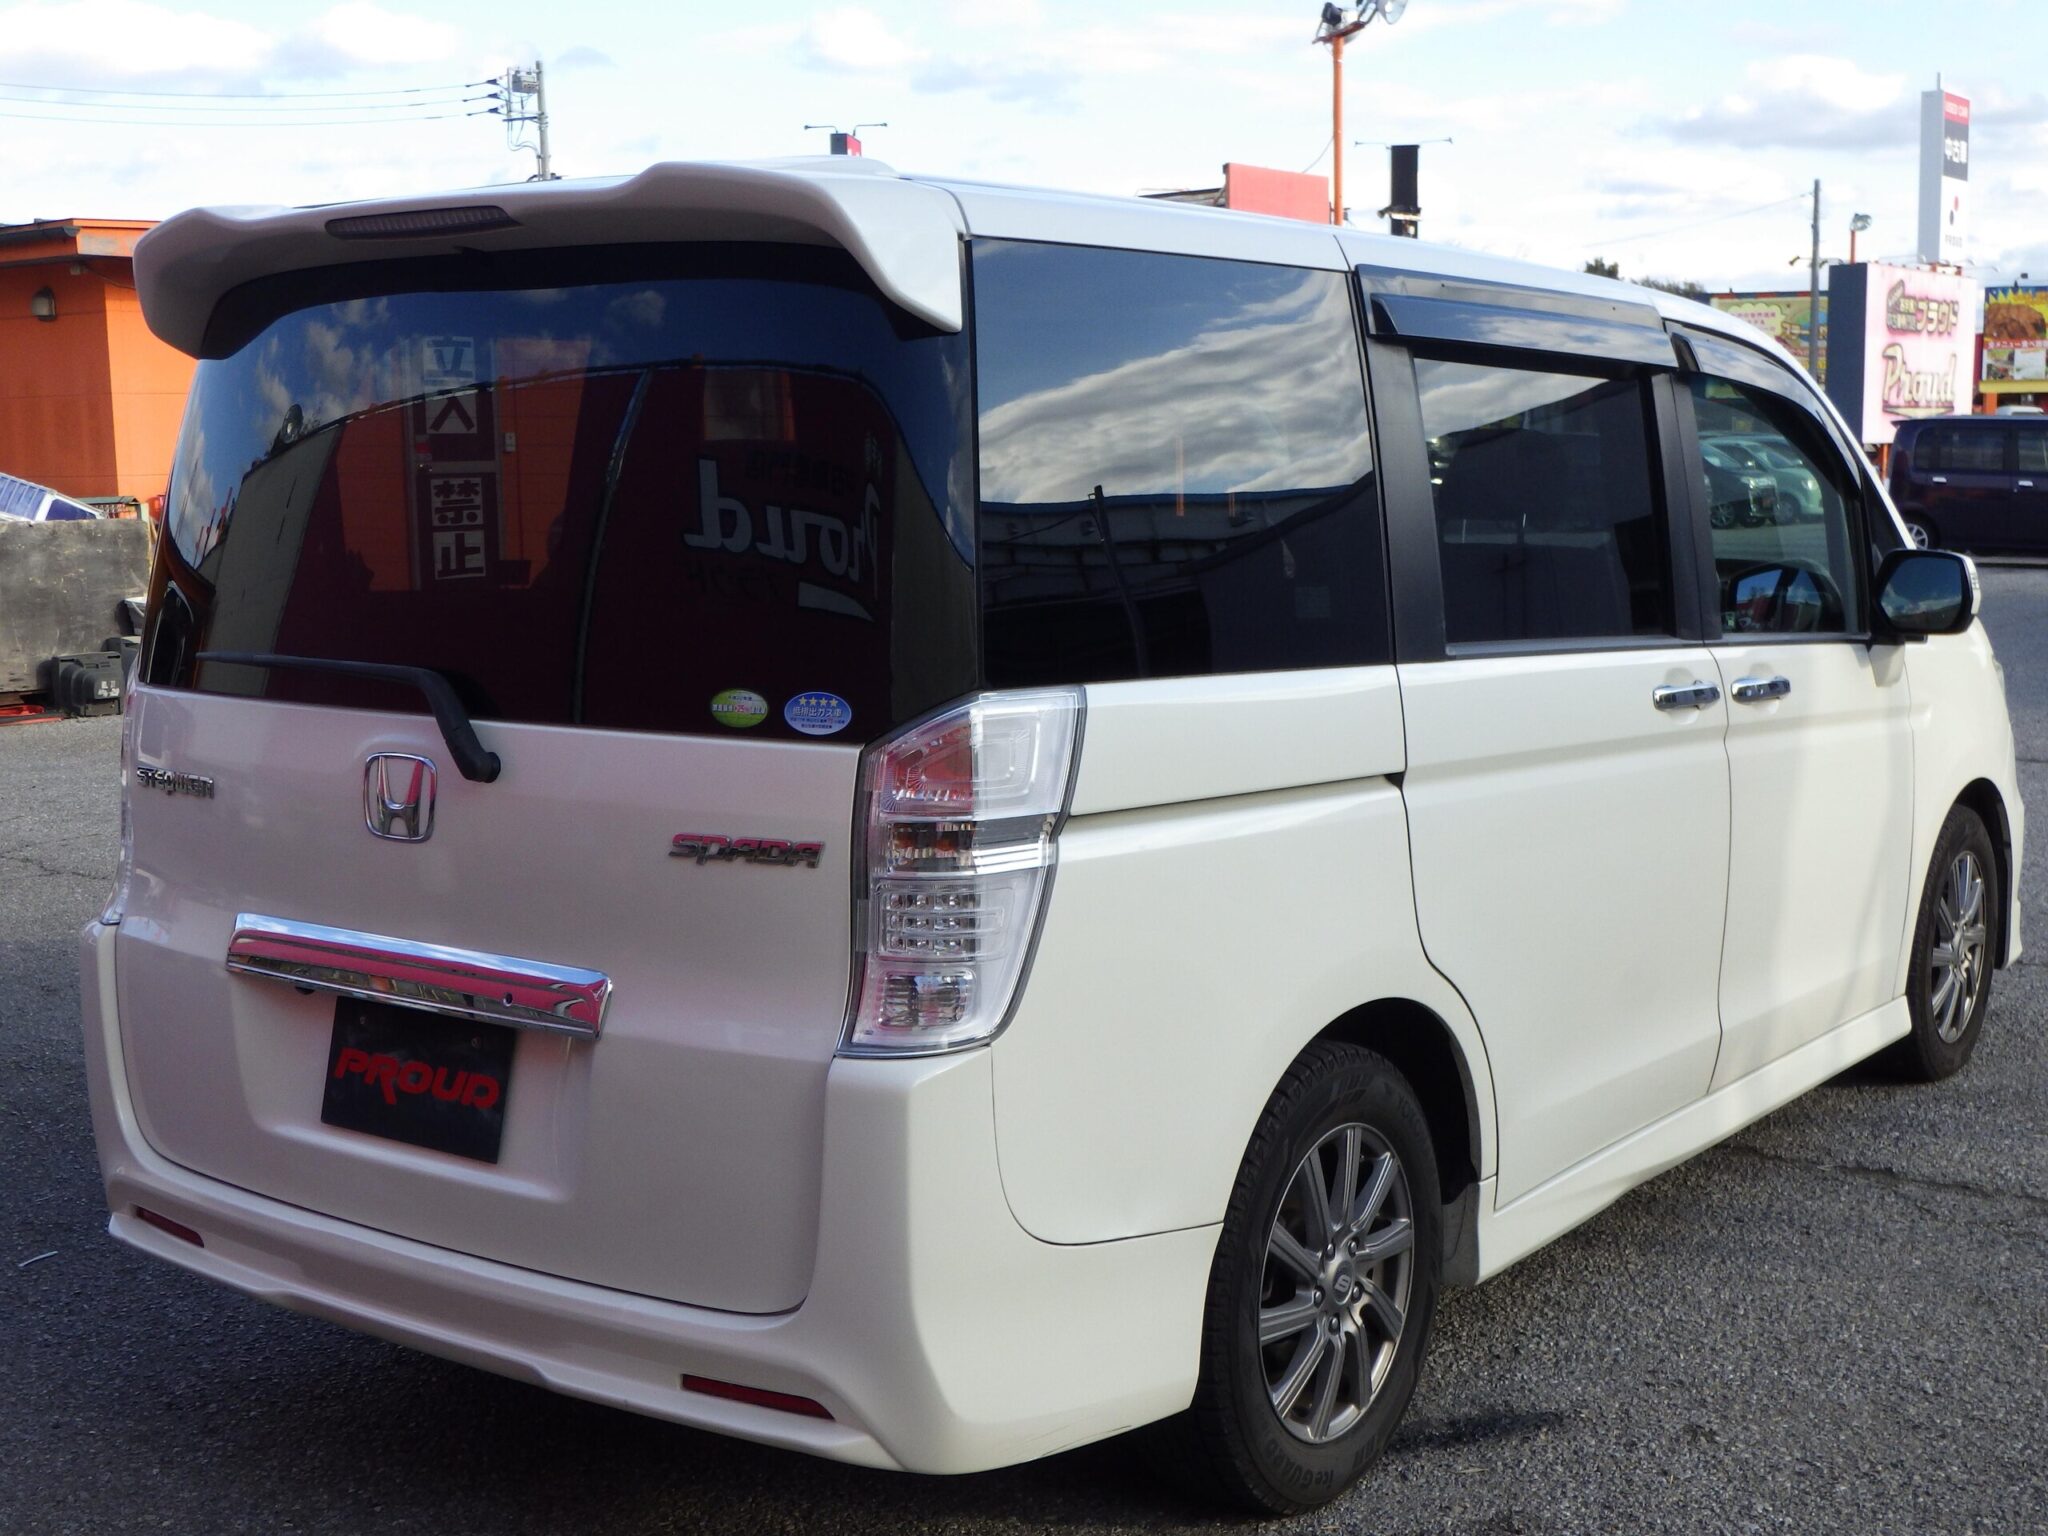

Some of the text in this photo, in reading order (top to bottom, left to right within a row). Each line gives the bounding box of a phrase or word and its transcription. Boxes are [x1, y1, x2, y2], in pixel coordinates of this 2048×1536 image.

[1915, 296, 1959, 336] プラウド
[1882, 342, 1957, 403] Proud
[668, 833, 825, 868] SPADA
[335, 1047, 500, 1109] PROUD
